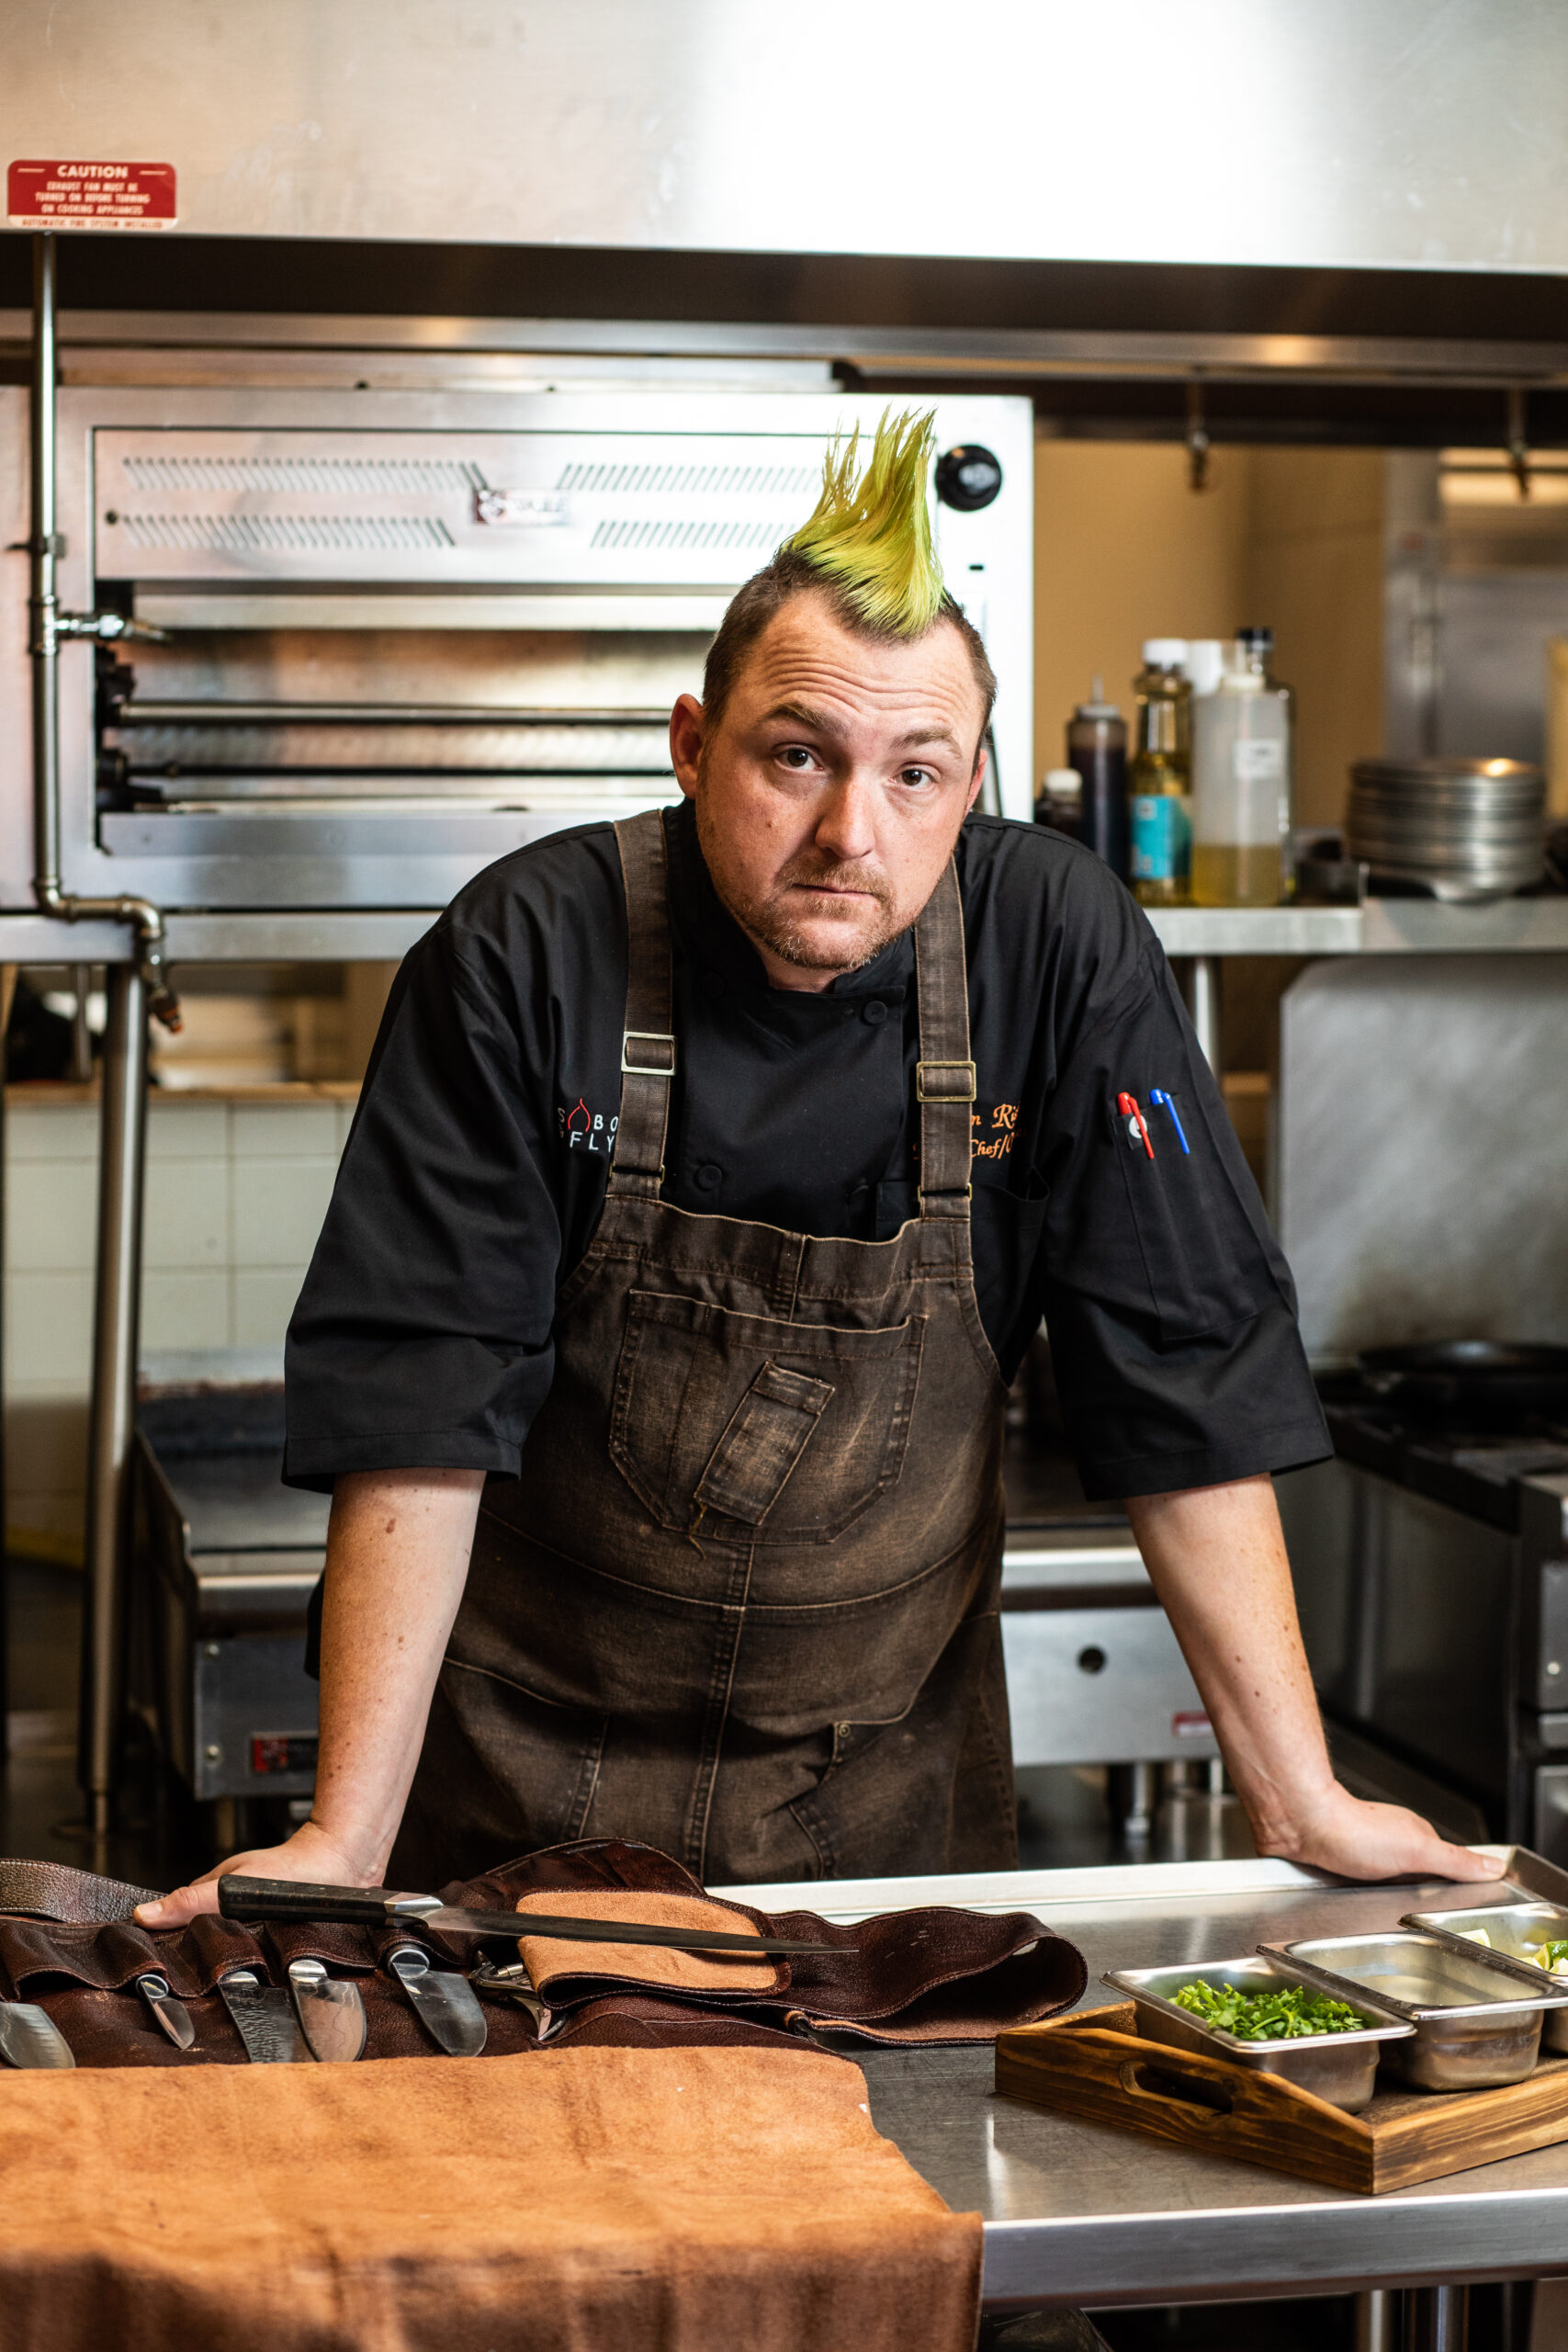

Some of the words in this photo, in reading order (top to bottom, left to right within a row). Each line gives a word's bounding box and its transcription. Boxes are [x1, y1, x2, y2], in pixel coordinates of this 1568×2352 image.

[57, 164, 129, 178] CAUTION
[46, 181, 82, 191] EXHAUST
[84, 181, 100, 191] FAN
[103, 182, 125, 192] MUST
[127, 182, 138, 192] BE
[35, 192, 66, 202] TURNED
[68, 192, 82, 202] ON
[85, 193, 113, 203] BEFORE
[115, 193, 151, 204] TURNING
[41, 203, 54, 213] ON
[57, 204, 94, 214] COOKING
[96, 205, 144, 215] APPLIANCES
[21, 219, 66, 227] AUTOMATIC
